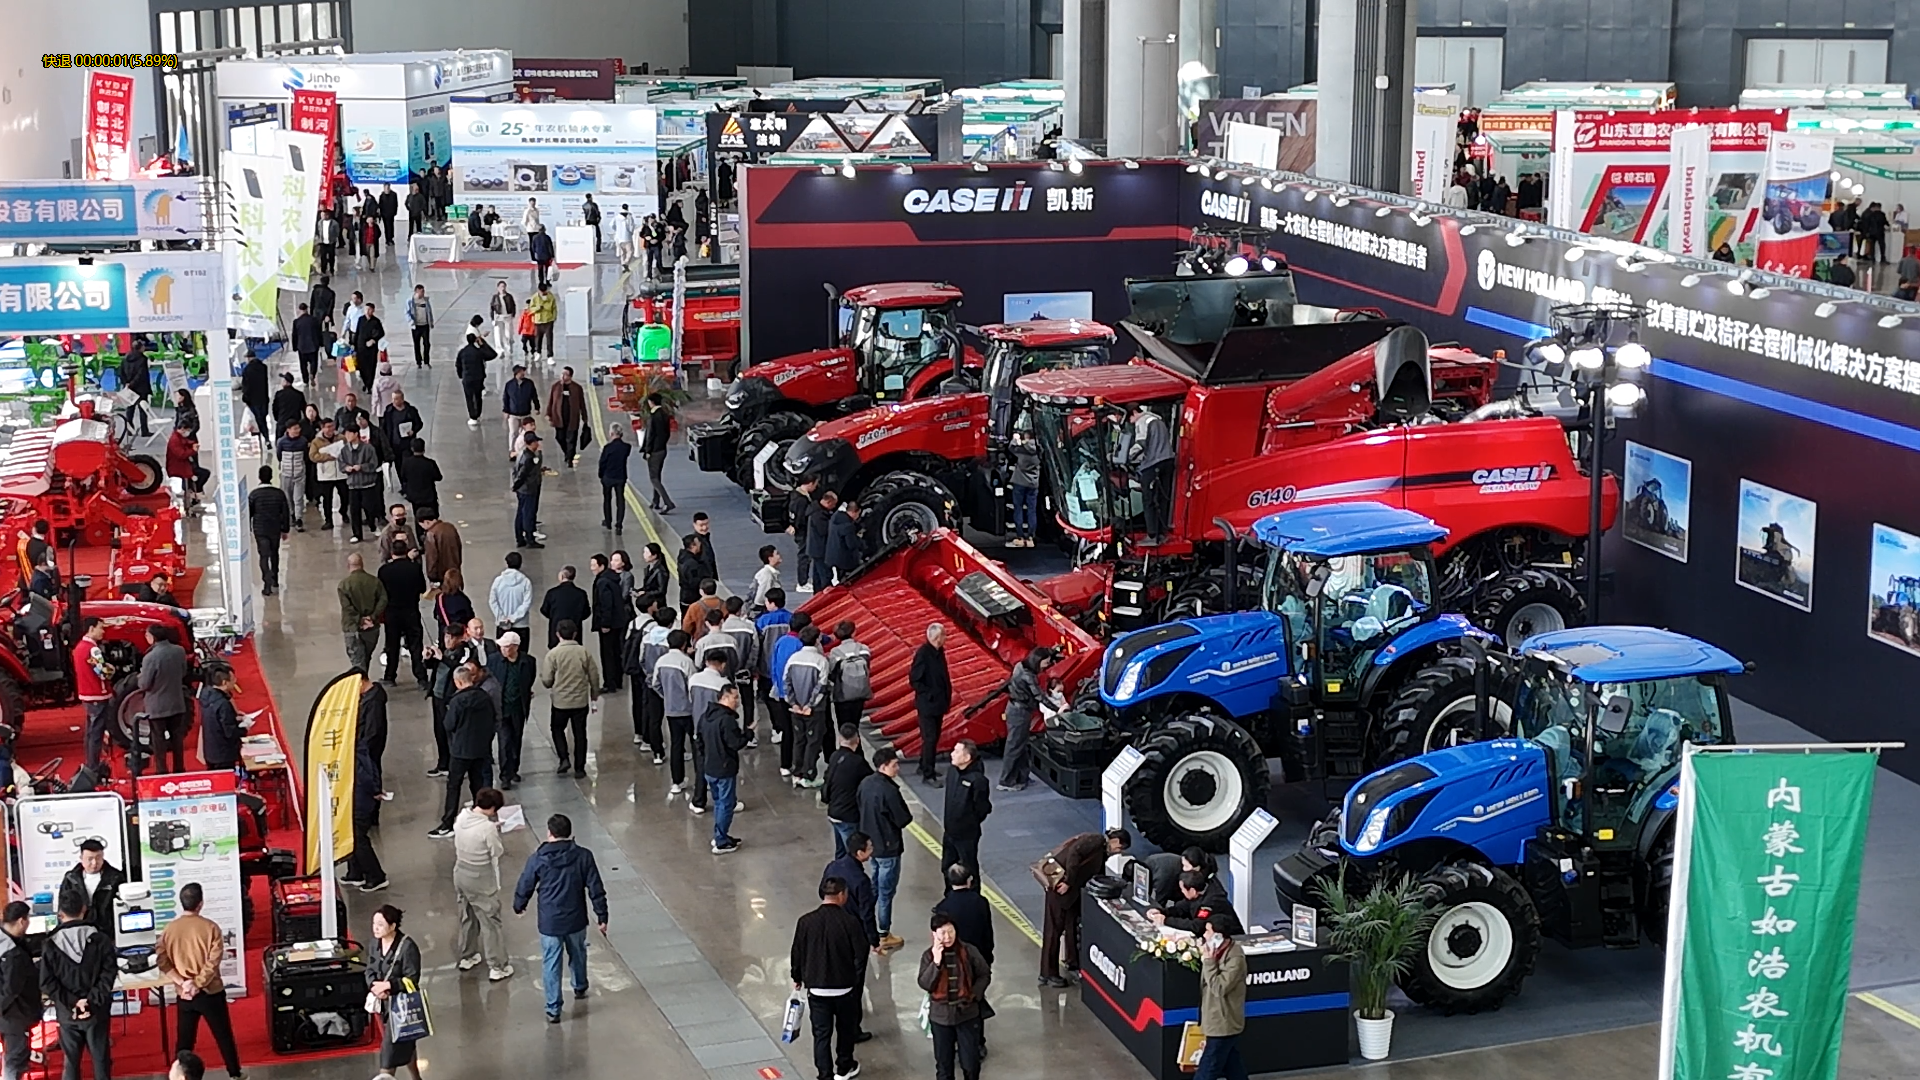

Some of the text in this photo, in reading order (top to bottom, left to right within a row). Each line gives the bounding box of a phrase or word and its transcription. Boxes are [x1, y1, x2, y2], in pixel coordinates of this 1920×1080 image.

[307, 73, 340, 83] Jinhe
[281, 174, 306, 233] 科农
[903, 188, 998, 213] CASE
[1047, 187, 1094, 211] 凯斯
[1201, 190, 1236, 221] CASE
[1683, 166, 1695, 254] Kverneland
[238, 202, 266, 267] 科农
[0, 280, 110, 315] 有限公司
[1497, 263, 1525, 290] NEW
[1525, 270, 1586, 305] HOLLAND
[139, 315, 183, 323] CHAMSUN
[1472, 467, 1531, 484] CASE
[1248, 485, 1296, 508] 6140
[1727, 777, 1804, 1080] 内蒙古如浩农机有
[1090, 945, 1117, 985] CASE
[1254, 968, 1311, 985] HOLLAND
